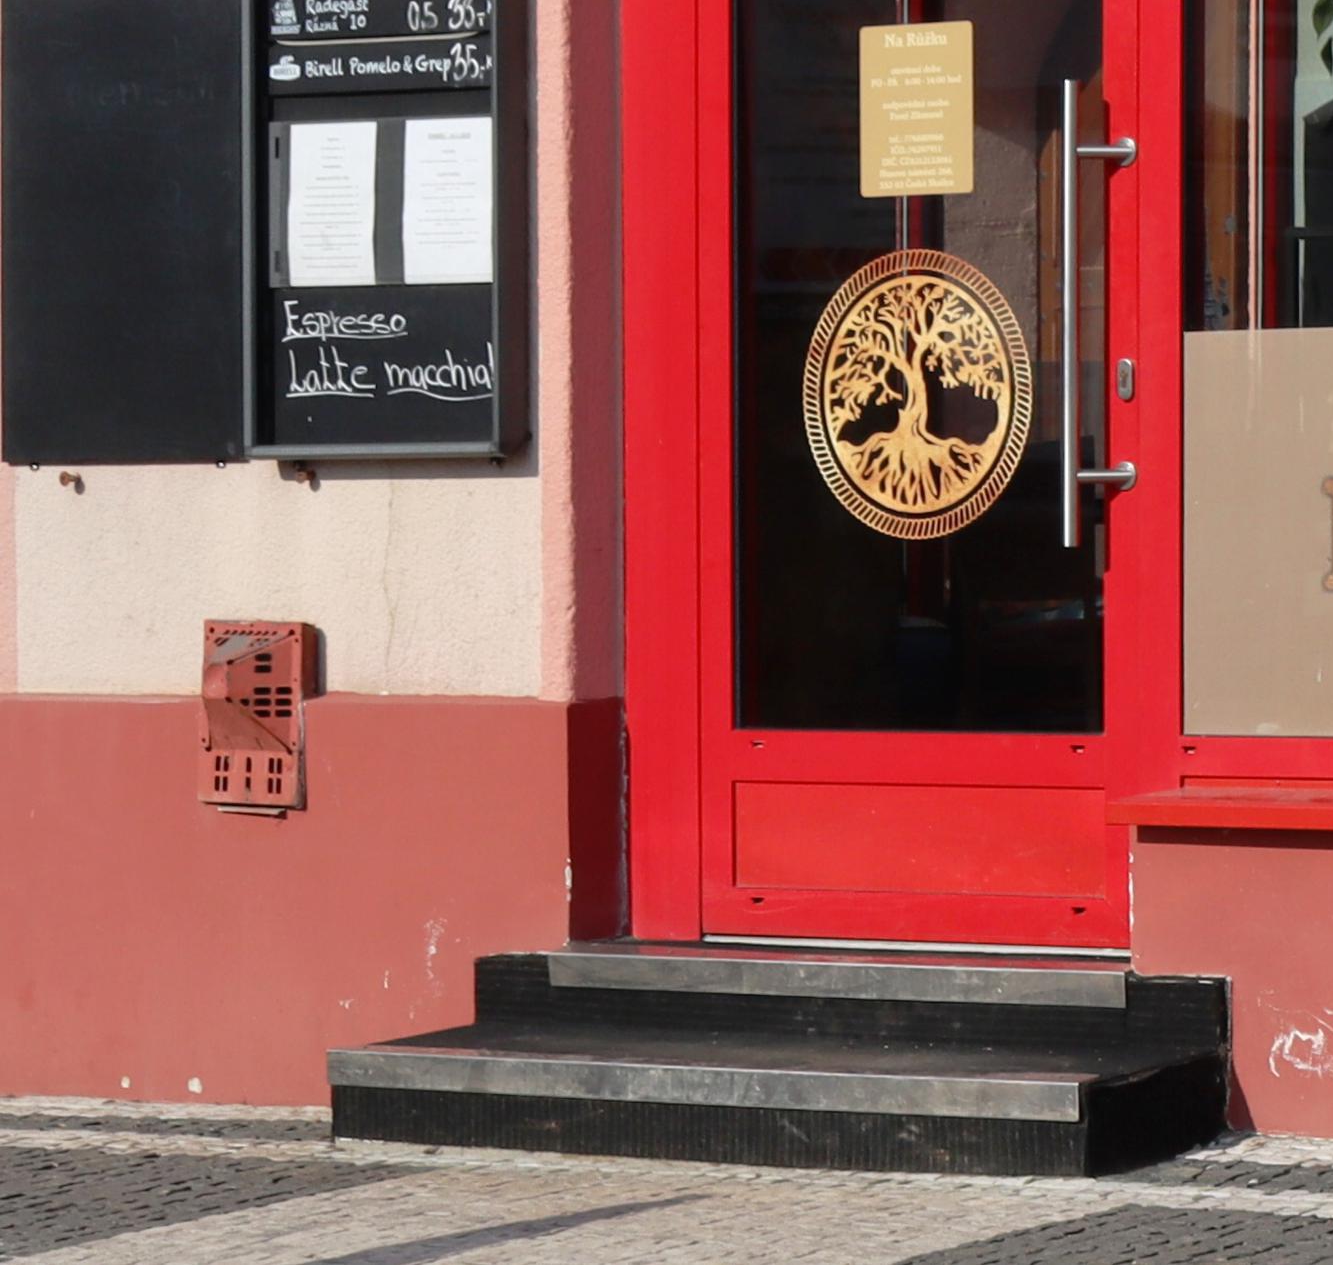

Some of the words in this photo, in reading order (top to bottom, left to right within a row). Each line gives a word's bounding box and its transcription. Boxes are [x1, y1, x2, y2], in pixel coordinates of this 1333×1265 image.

[350, 14, 367, 30] 10
[305, 56, 344, 78] Birell
[350, 56, 401, 75] Pomelo
[403, 55, 413, 74] &
[415, 54, 451, 82] Grep
[283, 300, 406, 341] Espresso
[289, 346, 376, 393] Latte
